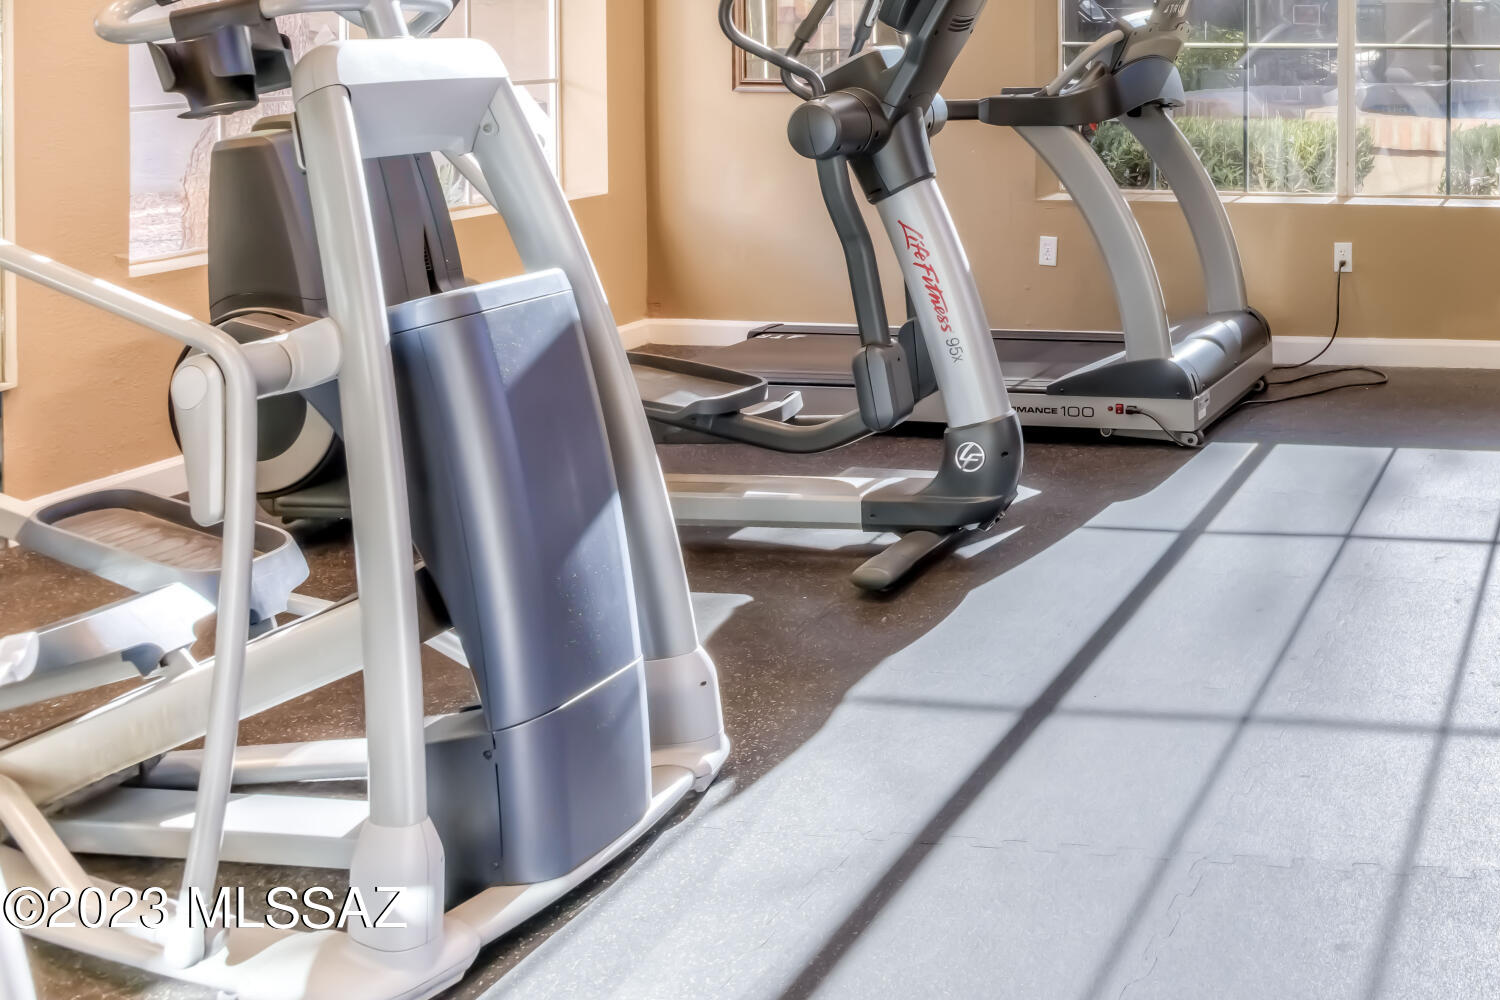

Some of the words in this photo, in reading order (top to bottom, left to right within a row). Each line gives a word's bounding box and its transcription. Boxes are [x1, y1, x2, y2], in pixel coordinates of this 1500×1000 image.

[897, 219, 930, 262] Life
[913, 261, 952, 333] Fitness
[1060, 400, 1095, 418] 100
